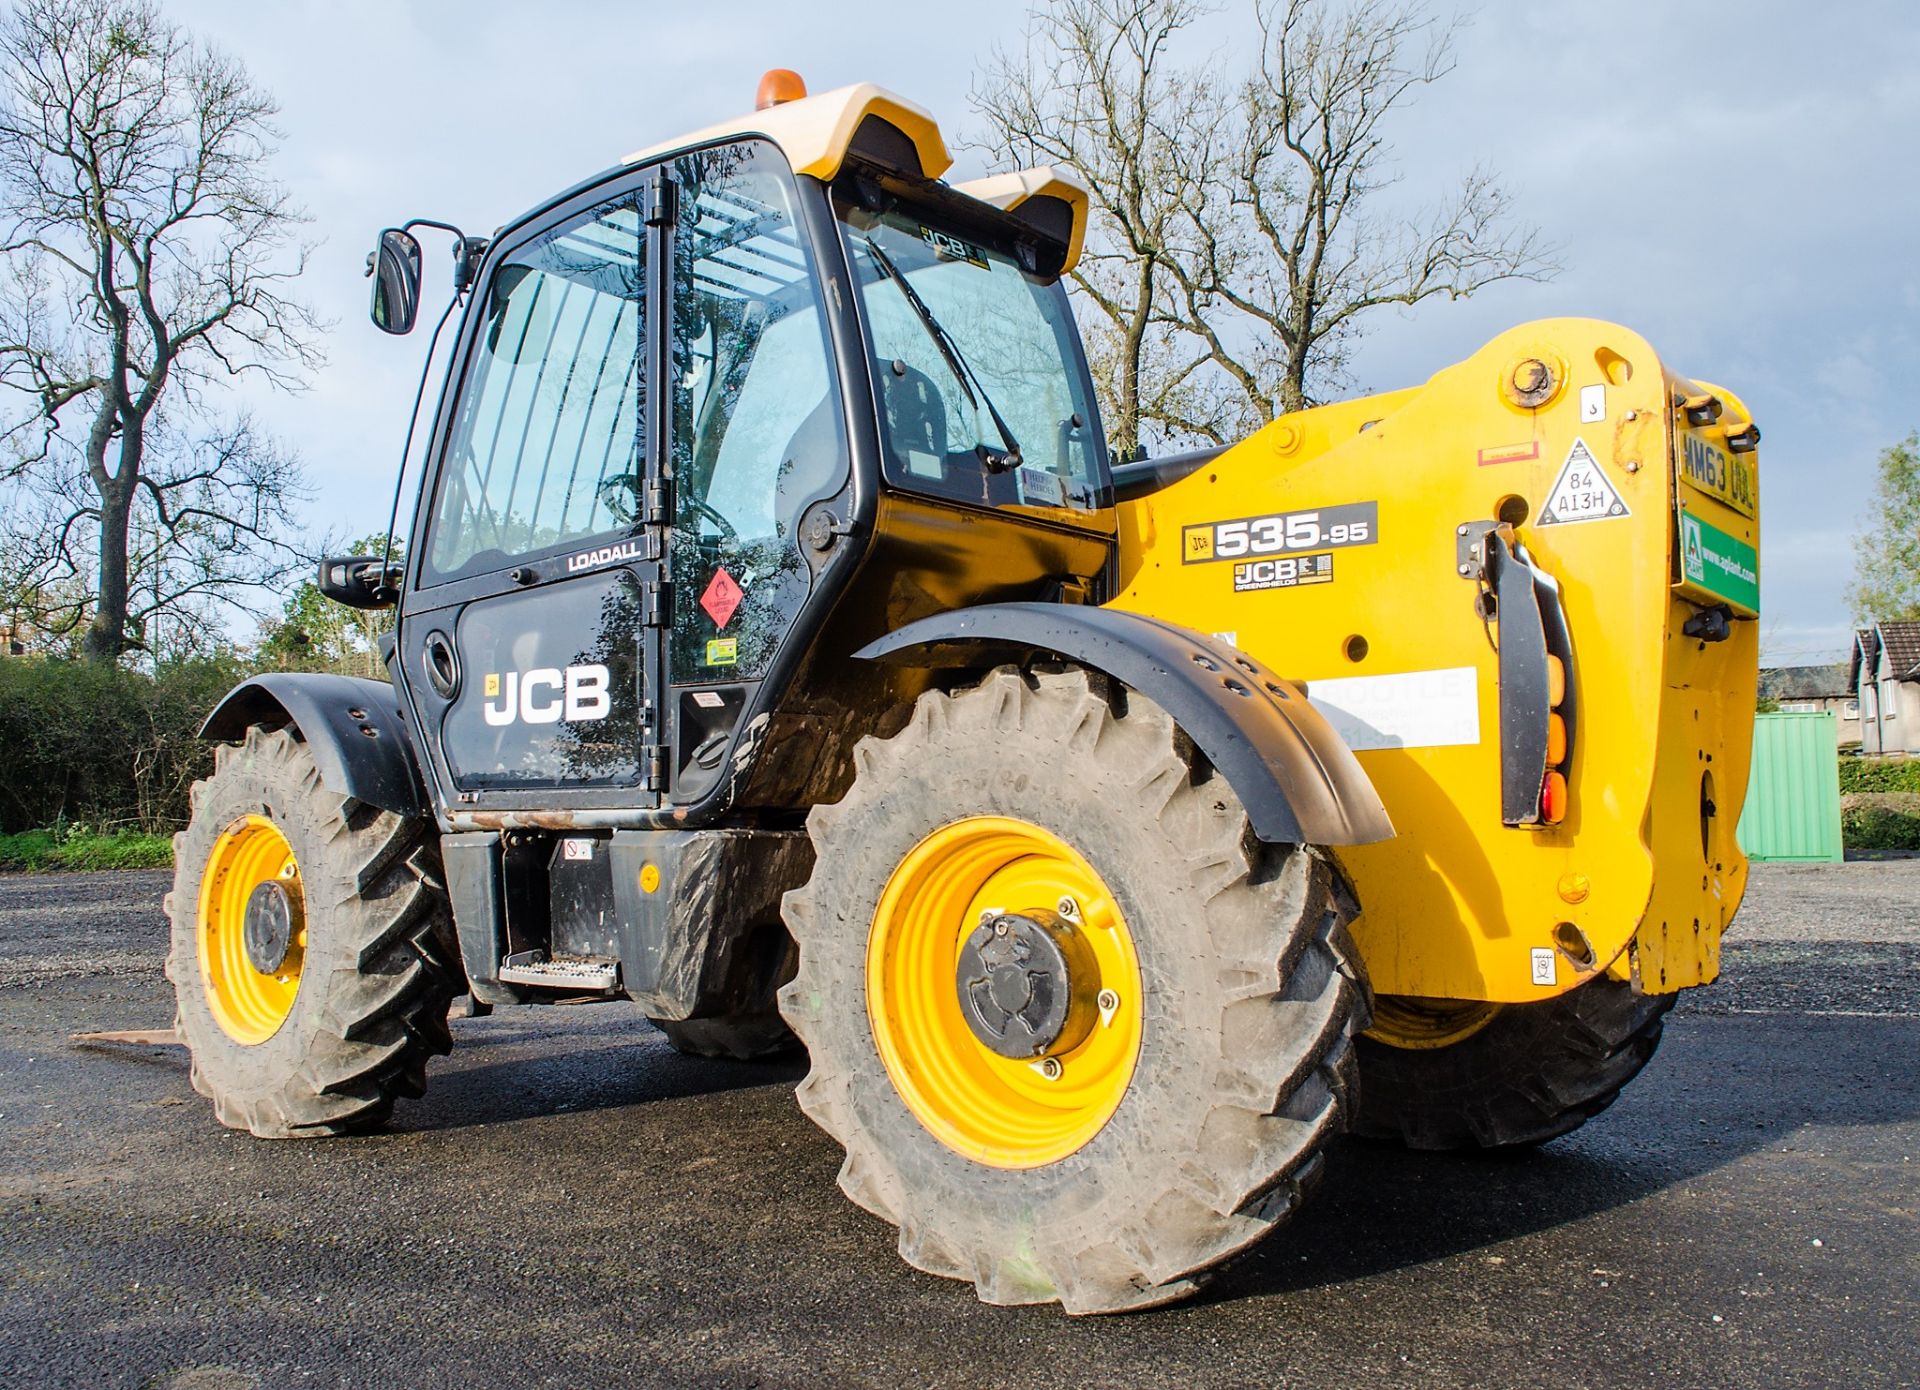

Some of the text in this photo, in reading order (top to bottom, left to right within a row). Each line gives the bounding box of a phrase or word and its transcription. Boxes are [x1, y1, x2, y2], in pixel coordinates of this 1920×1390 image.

[923, 229, 967, 256] JCB
[1683, 433, 1726, 492] MM63
[1570, 471, 1593, 490] 84
[568, 542, 641, 572] LOADALL
[1235, 559, 1297, 584] JCB
[484, 664, 611, 726] JCB
